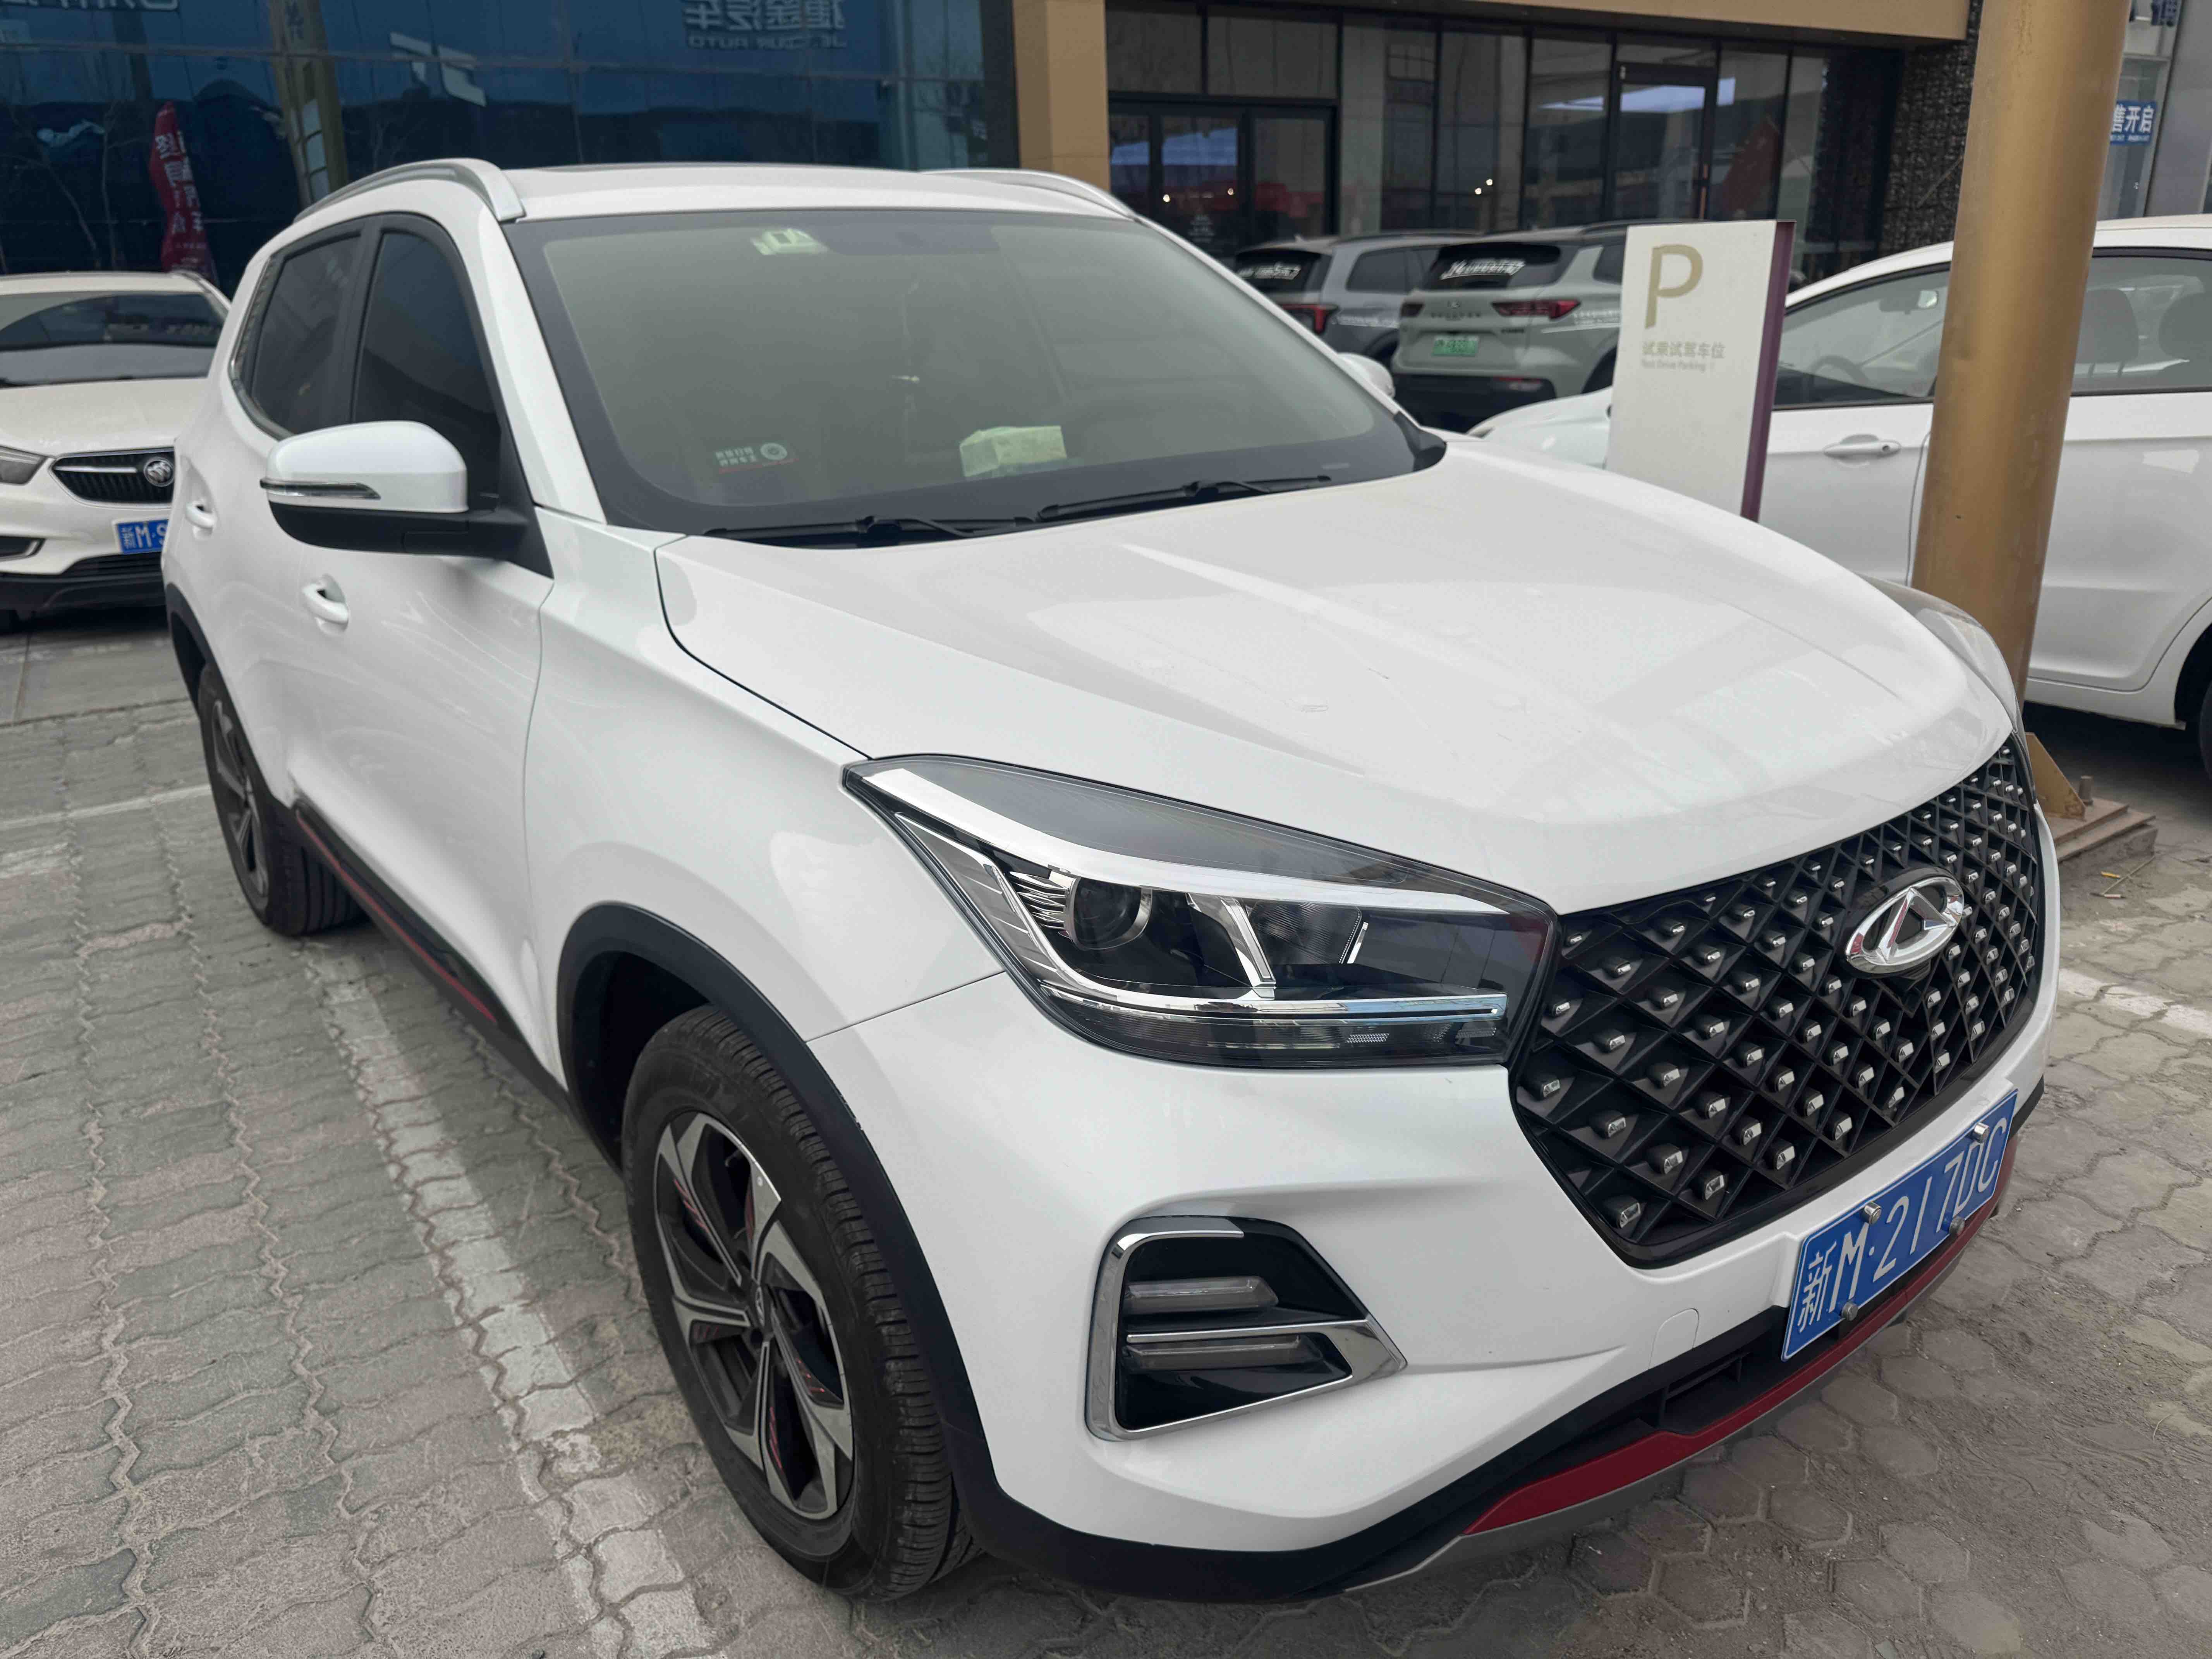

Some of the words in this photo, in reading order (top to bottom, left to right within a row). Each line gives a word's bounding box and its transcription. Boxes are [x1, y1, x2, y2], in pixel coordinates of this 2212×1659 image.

[1645, 244, 1703, 329] P
[1642, 341, 1726, 359] 试乘试驾车位
